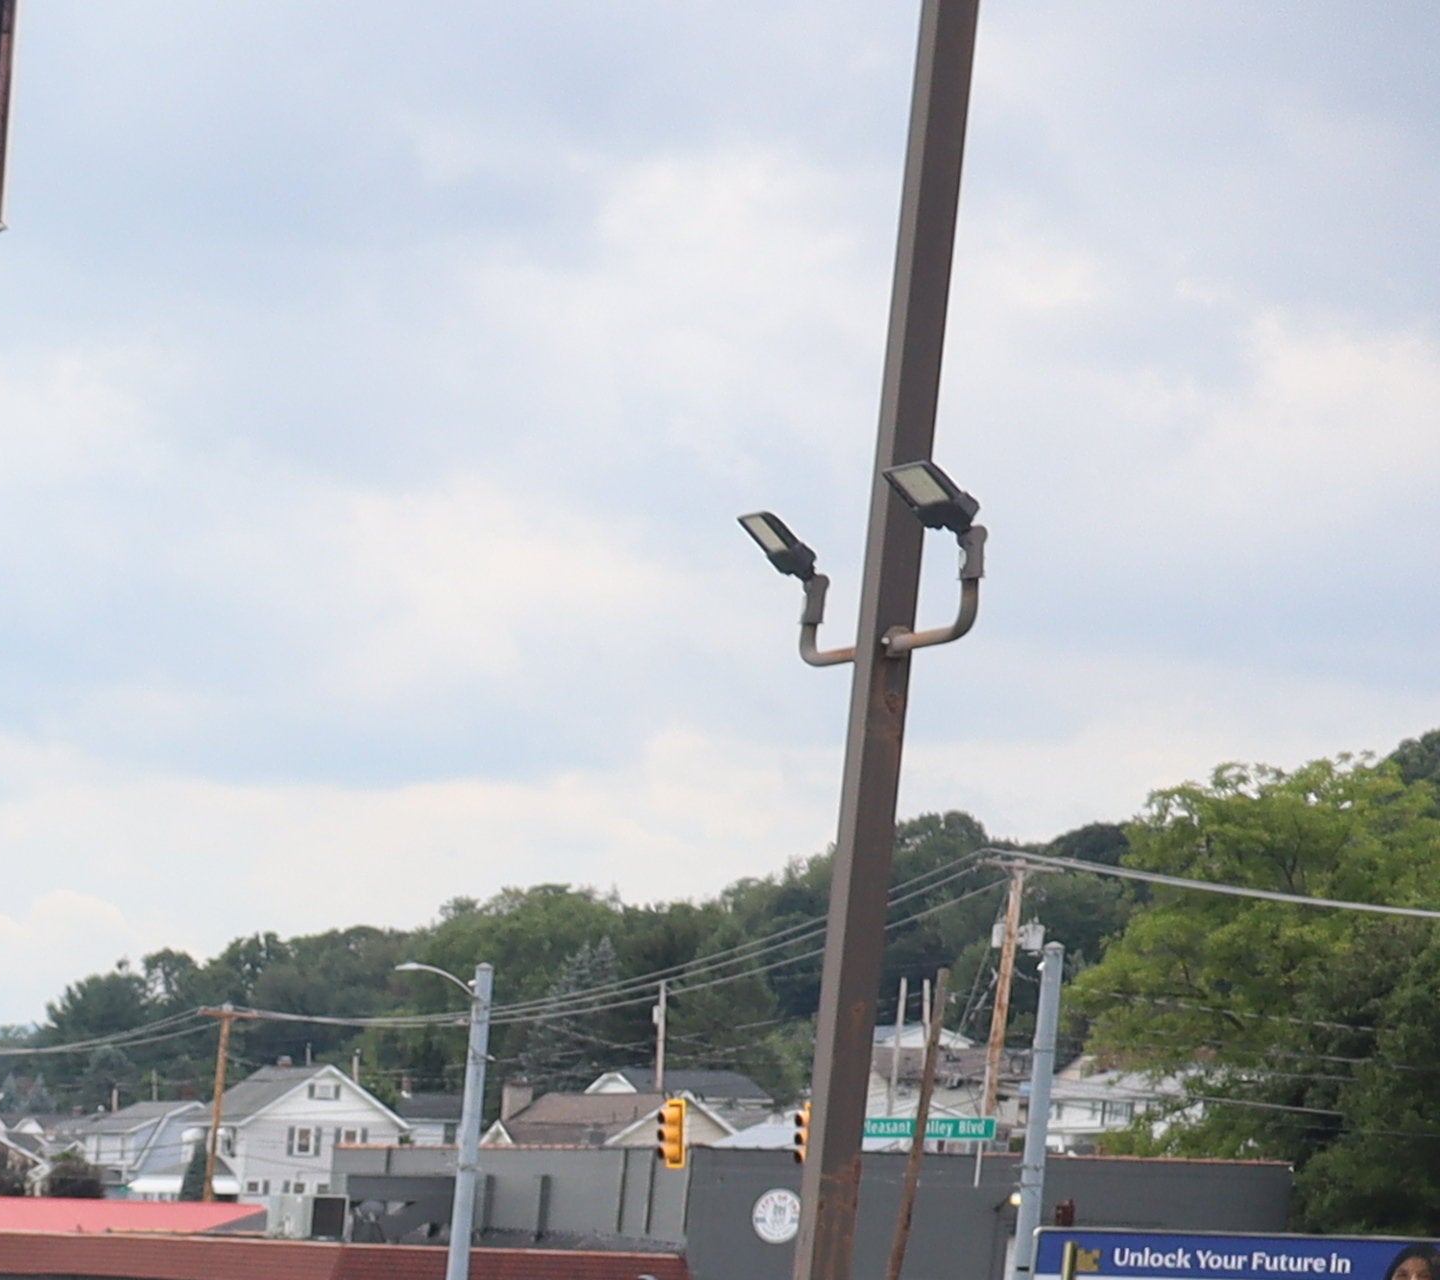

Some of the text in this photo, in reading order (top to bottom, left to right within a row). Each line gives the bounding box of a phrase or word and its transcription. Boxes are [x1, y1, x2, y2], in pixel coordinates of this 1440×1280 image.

[864, 1120, 986, 1137] leasant lley Blvd
[1113, 1247, 1351, 1274] Unlock Your Future in
